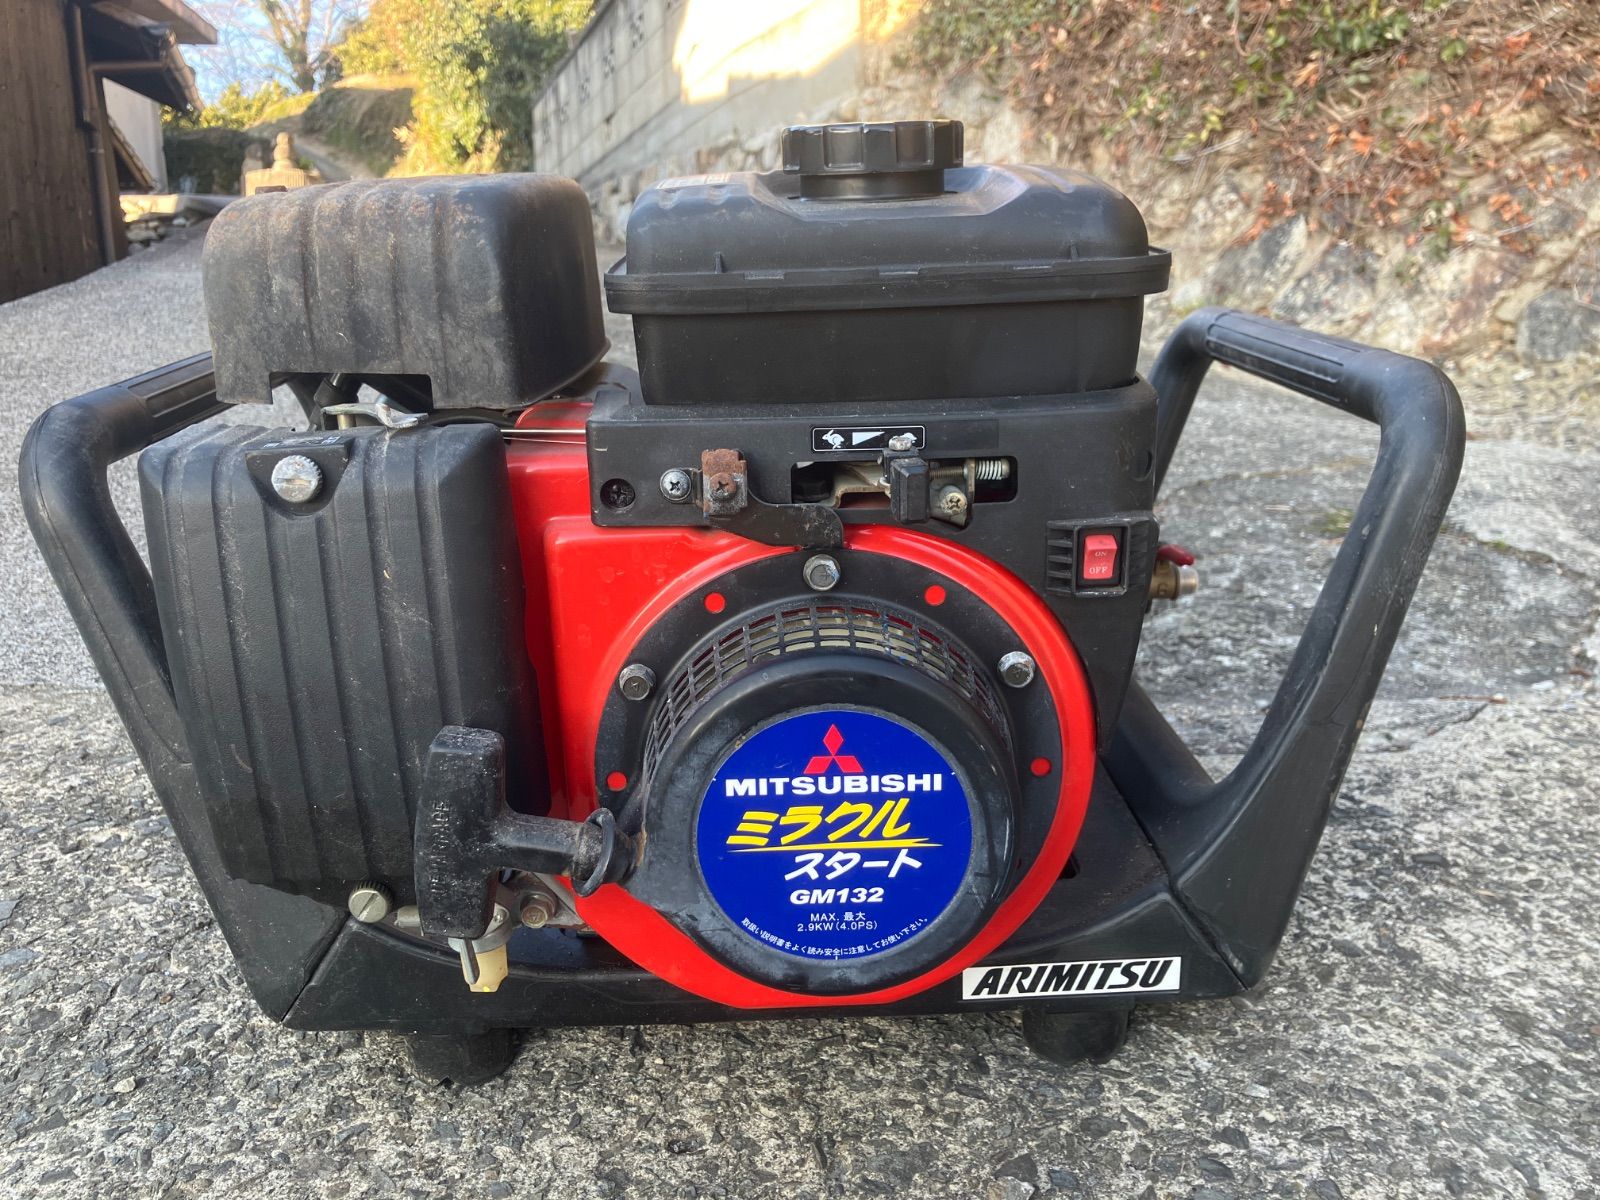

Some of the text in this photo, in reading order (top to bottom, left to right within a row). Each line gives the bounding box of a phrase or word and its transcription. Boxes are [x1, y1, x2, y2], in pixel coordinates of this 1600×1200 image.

[1088, 566, 1108, 575] OFF
[725, 773, 943, 797] MITSUBISHI
[726, 798, 912, 847] ミラクル
[784, 848, 923, 881] スタート
[789, 887, 885, 905] GM132
[810, 911, 866, 922] MAX. 最大
[970, 959, 1174, 996] ARIMITSU
